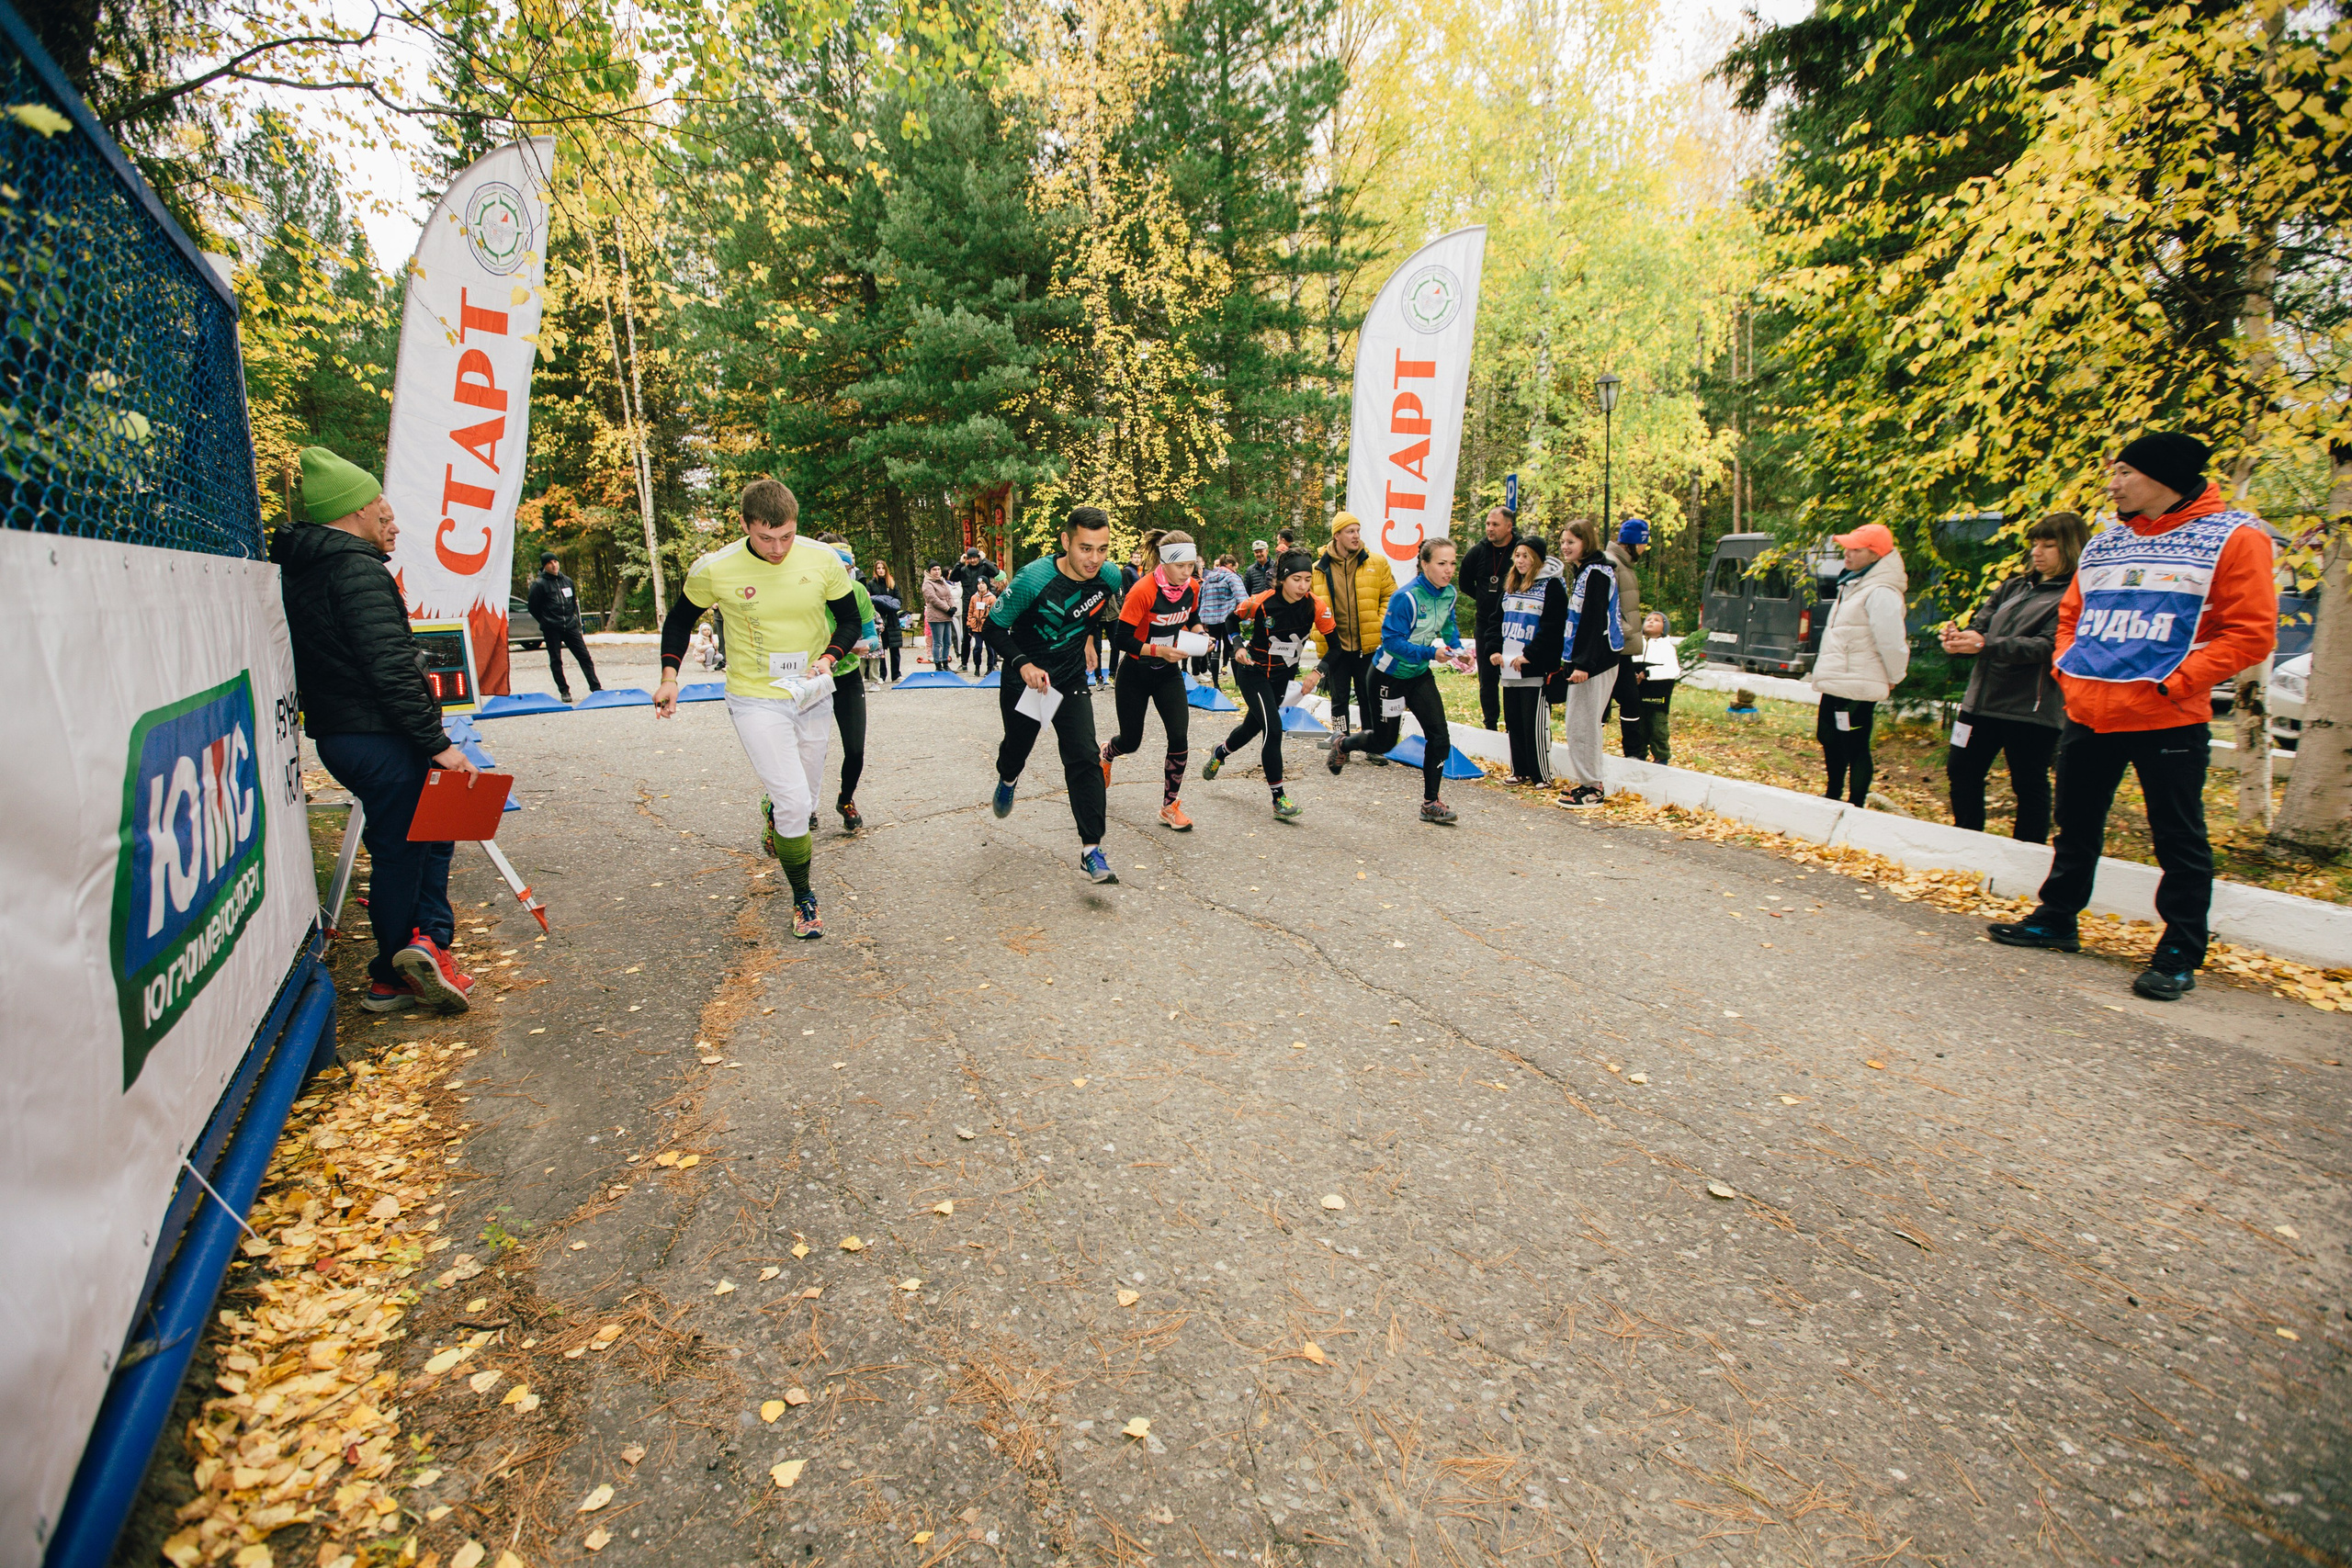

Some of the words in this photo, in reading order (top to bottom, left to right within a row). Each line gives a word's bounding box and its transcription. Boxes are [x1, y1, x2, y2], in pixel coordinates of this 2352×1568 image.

[435, 287, 509, 576] СТАРТ
[1381, 347, 1436, 562] СТАРТ
[1507, 479, 1515, 508] P
[1072, 591, 1104, 618] O-UGRA
[2077, 608, 2177, 643] СУДЬЯ
[780, 661, 797, 671] 401
[147, 721, 254, 940] ЮМС
